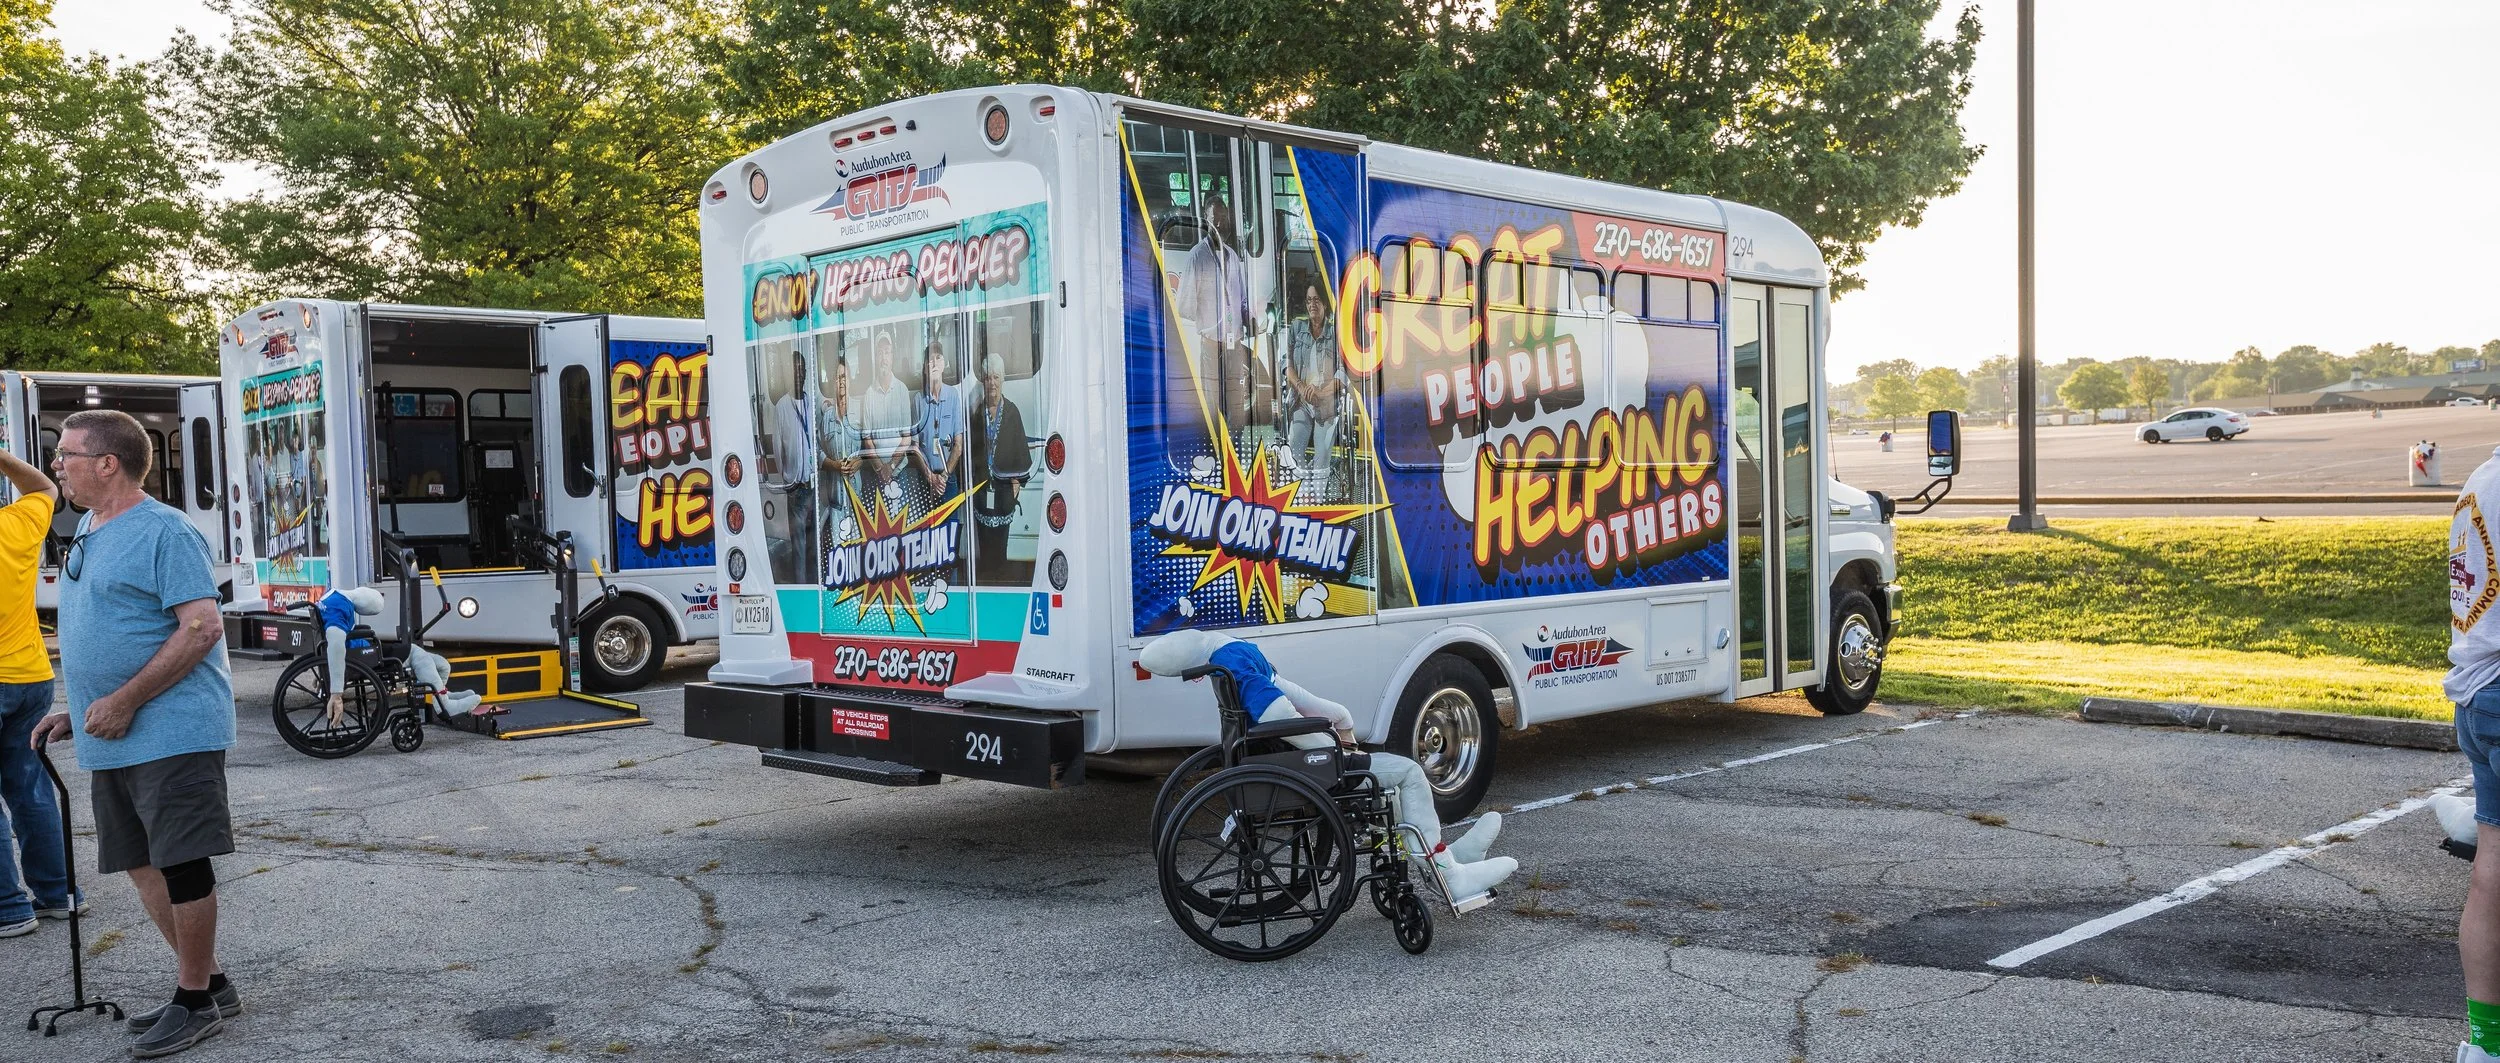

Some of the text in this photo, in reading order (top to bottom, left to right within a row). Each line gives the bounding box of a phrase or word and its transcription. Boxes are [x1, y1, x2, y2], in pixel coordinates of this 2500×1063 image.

[851, 150, 912, 174] AudubonArea
[845, 163, 918, 221] GRITS
[840, 209, 929, 236] PUBLIC TRANSPORTATION
[1593, 221, 1714, 267] 270-686-1651
[1733, 235, 1754, 258] 294
[753, 228, 1027, 323] ENJOY HELPING PEOPLE?
[1338, 224, 1564, 376] GREAT
[1424, 337, 1576, 424] PEOPLE
[1475, 386, 1712, 565] HELPING
[1149, 484, 1356, 571] JOIN OUR TEAM!
[1586, 482, 1721, 569] OTHERS
[825, 521, 958, 585] JOIN OUR TEAM!
[2473, 515, 2495, 574] ANNUAL
[291, 630, 302, 646] 297
[1551, 625, 1606, 640] AudubonArea
[833, 646, 956, 683] 270-686-1651
[1552, 638, 1607, 672] GRITS
[1026, 667, 1075, 682] STARCRAFT
[1535, 669, 1618, 689] PUBLIC TRANSPORTATION
[1656, 675, 1663, 685] US
[1664, 673, 1674, 684] DOT
[833, 709, 889, 722] THIS VEHICLE STOPS
[844, 727, 877, 737] CROSSINGS
[845, 718, 855, 726] ALL
[856, 720, 884, 730] RAILROAD
[965, 731, 1002, 765] 294
